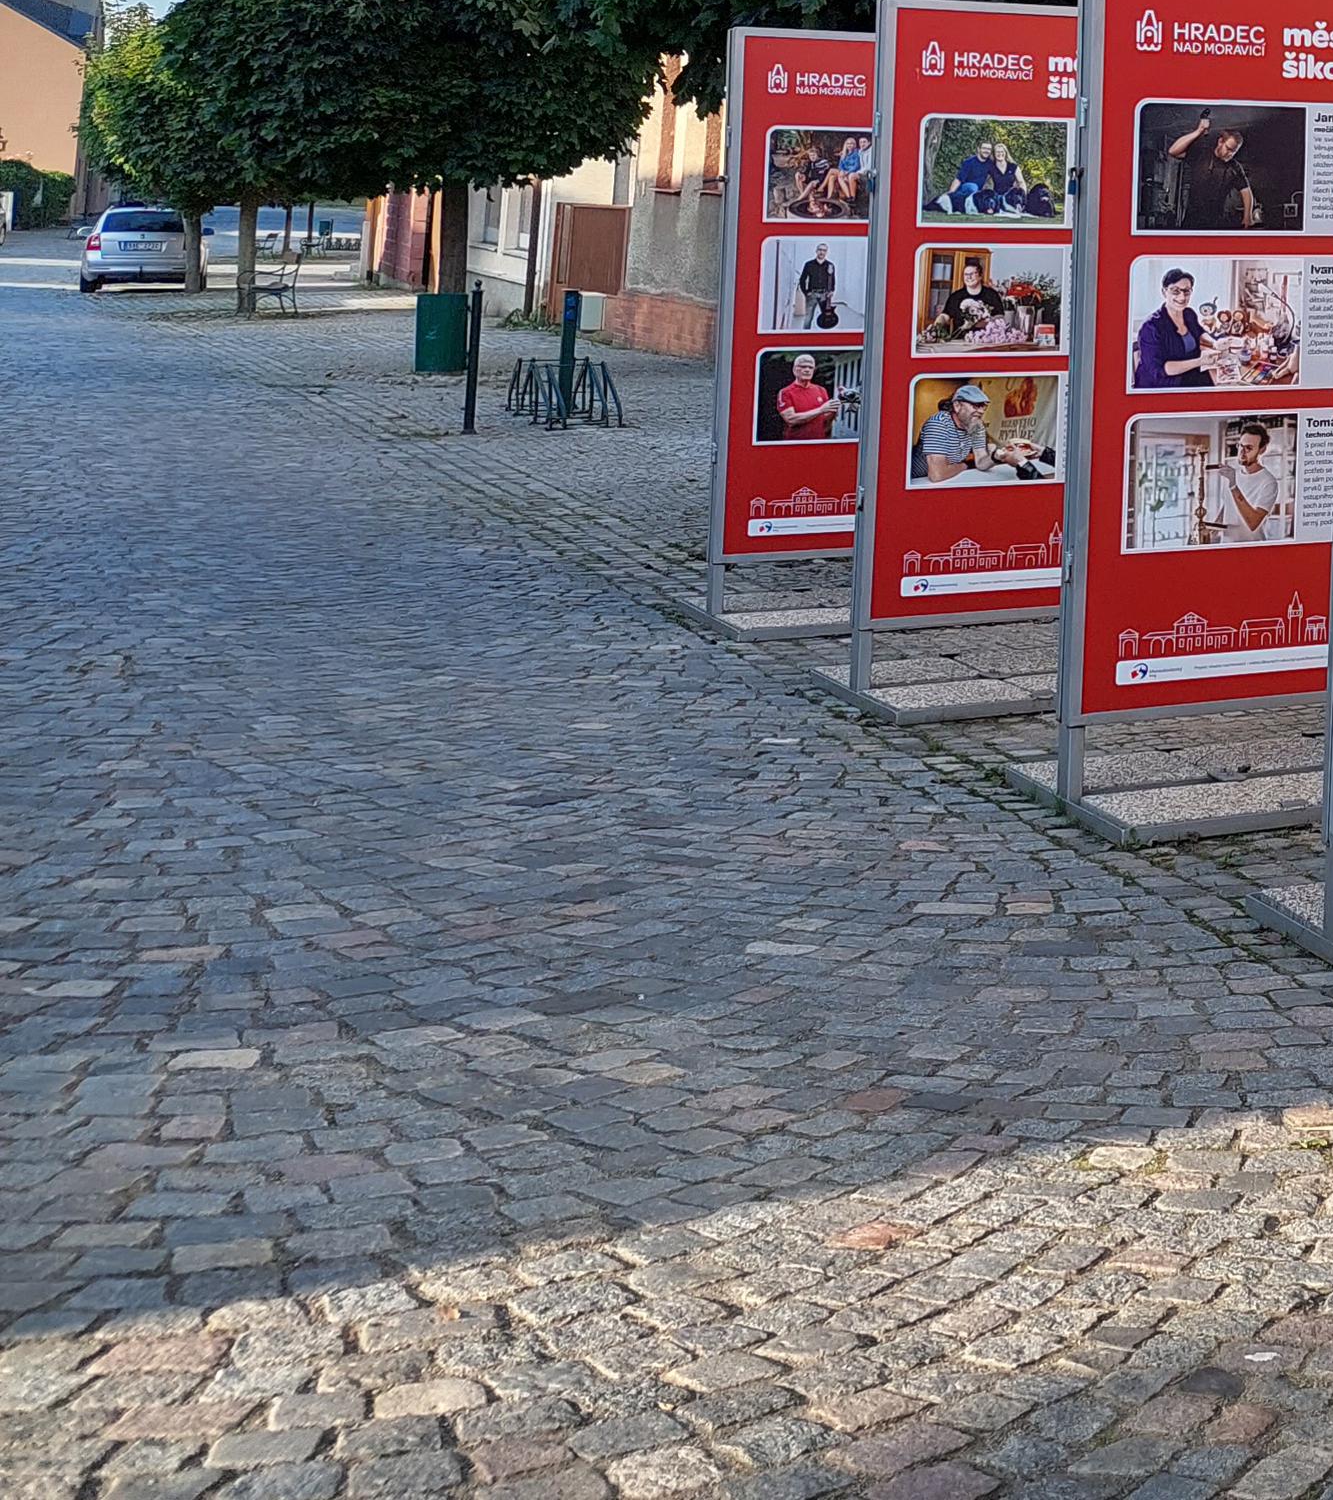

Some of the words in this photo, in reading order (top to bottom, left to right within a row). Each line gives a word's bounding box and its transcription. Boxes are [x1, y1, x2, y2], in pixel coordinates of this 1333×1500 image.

[1173, 22, 1265, 44] HRADEC
[1173, 42, 1201, 53] NAD
[1204, 43, 1266, 57] MORAVICÍ
[954, 52, 1033, 70] HRADEC
[796, 73, 866, 87] HRADEC
[954, 68, 978, 78] NAD
[980, 69, 1033, 80] MORAVICÍ
[795, 86, 817, 95] NAD
[819, 87, 867, 97] MORAVICÍ
